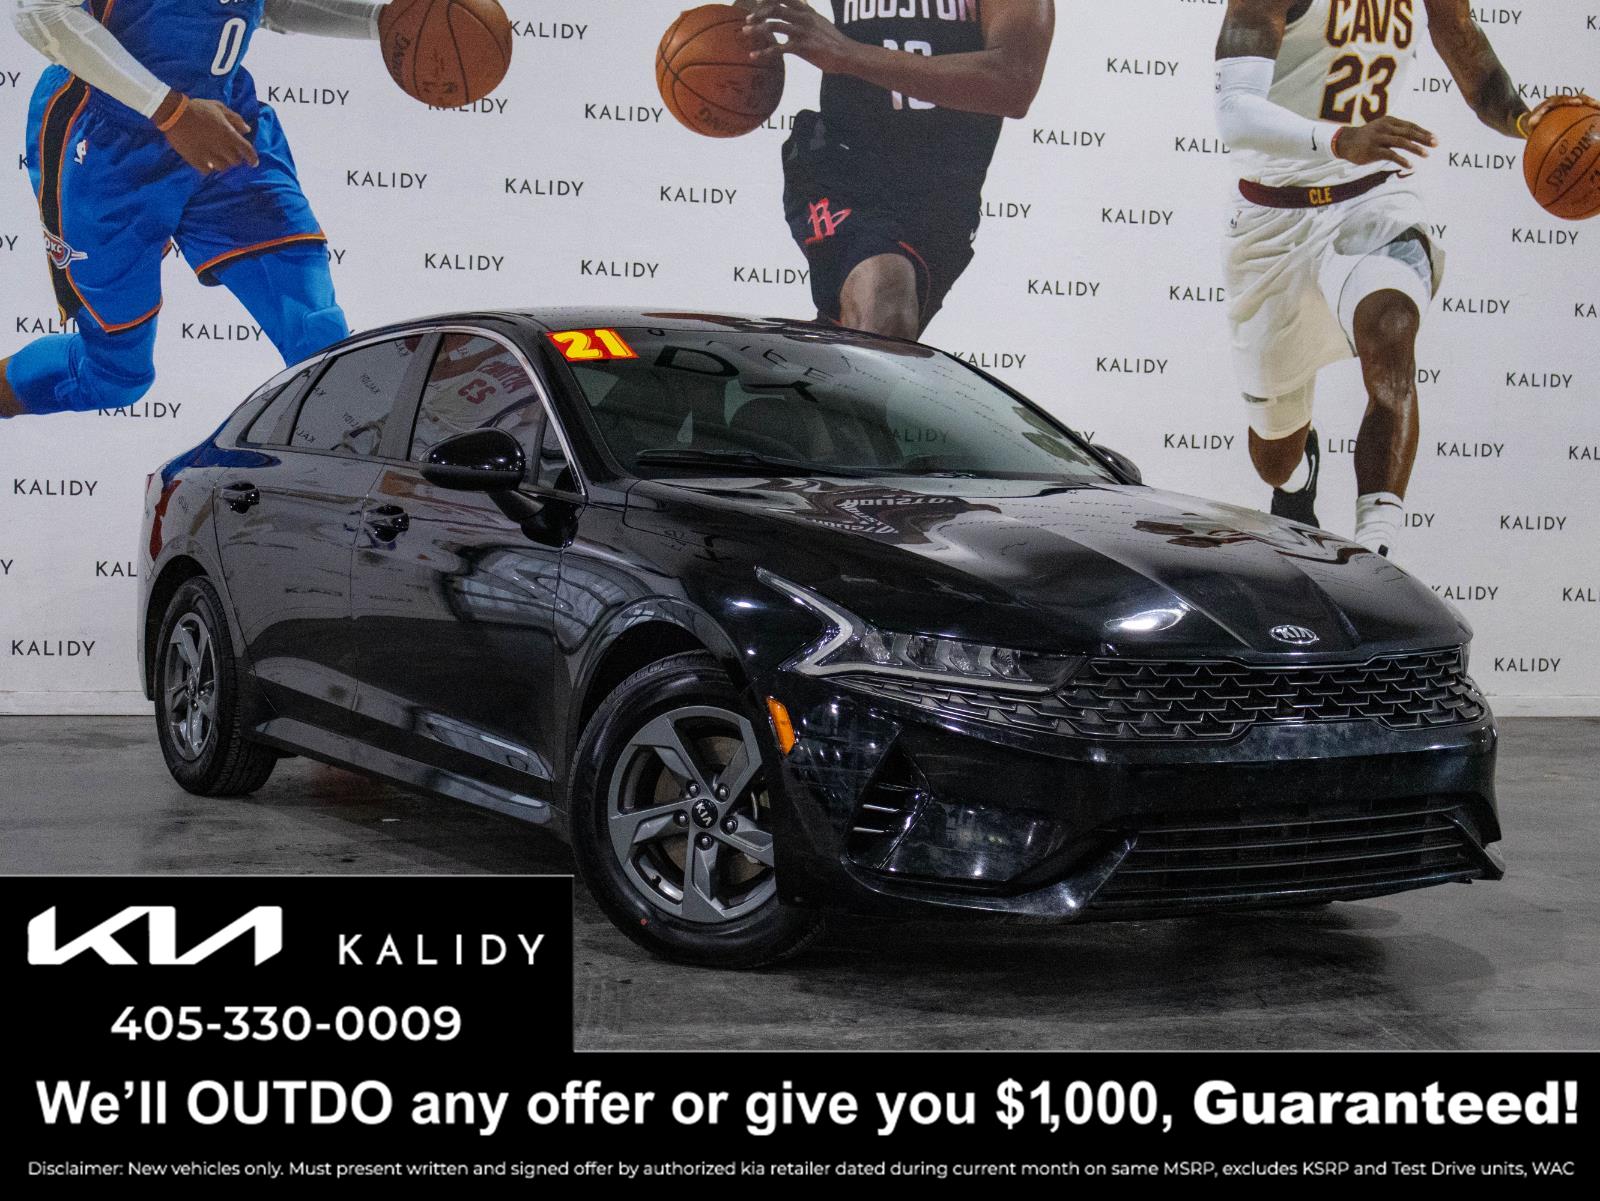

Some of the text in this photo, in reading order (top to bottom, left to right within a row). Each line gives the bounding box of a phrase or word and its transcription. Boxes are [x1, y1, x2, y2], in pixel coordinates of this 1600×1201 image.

[1326, 0, 1413, 49] CAVS
[1469, 8, 1522, 24] ALIDY
[211, 17, 246, 76] 0
[1107, 57, 1179, 76] KALIDY
[268, 86, 349, 105] KALIDY
[1319, 53, 1396, 125] 23
[585, 103, 663, 123] KALIDY
[1033, 128, 1105, 147] KALIDY
[1449, 152, 1516, 170] KALIDY
[347, 170, 427, 189] KALIDY
[505, 178, 584, 197] KALIDY
[660, 186, 737, 205] KALIDY
[979, 202, 1032, 218] LIDY
[1102, 207, 1173, 226] KALIDY
[1511, 227, 1579, 246] KALIDY
[425, 252, 504, 272] KALIDY
[581, 259, 659, 278] KALIDY
[734, 266, 810, 285] KALIDY
[1028, 279, 1100, 297] KALIDY
[1169, 285, 1225, 302] KALID
[1442, 297, 1510, 315] KALIDY
[182, 323, 263, 341] KALIDY
[553, 329, 633, 359] 21
[1097, 357, 1168, 375] KALIDY
[1505, 371, 1573, 389] KALIDY
[1164, 433, 1234, 450] KALIDY
[1437, 441, 1504, 458] KALIDY
[14, 478, 98, 497] KALIDY
[1500, 514, 1567, 531] KALIDY
[1274, 626, 1315, 640] KIA
[11, 639, 95, 657] KALIDY
[1494, 656, 1561, 673] KALIDY
[695, 802, 712, 827] KIA
